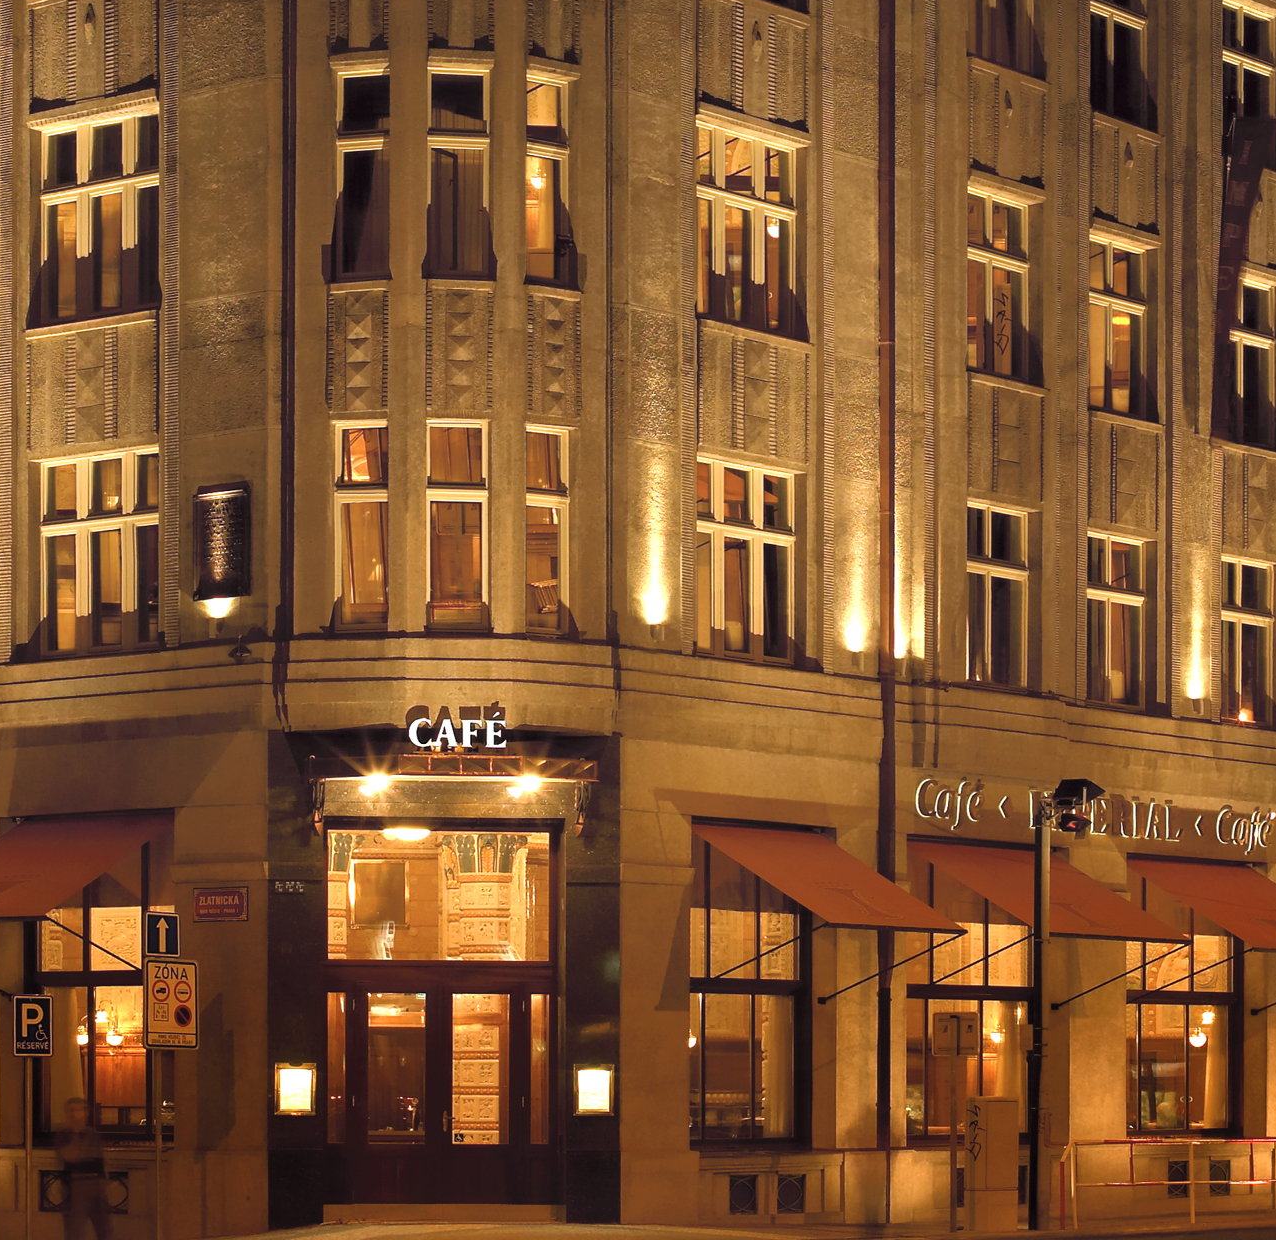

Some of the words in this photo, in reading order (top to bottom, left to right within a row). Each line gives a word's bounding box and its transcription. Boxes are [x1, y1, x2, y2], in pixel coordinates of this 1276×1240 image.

[408, 711, 507, 748] CAFÉ
[915, 778, 986, 831] Café
[1029, 788, 1184, 842] IERIAL
[1216, 808, 1276, 856] Café
[198, 892, 239, 906] ZLATNICKÁ
[154, 963, 188, 980] ZÓNA
[21, 1003, 44, 1037] P
